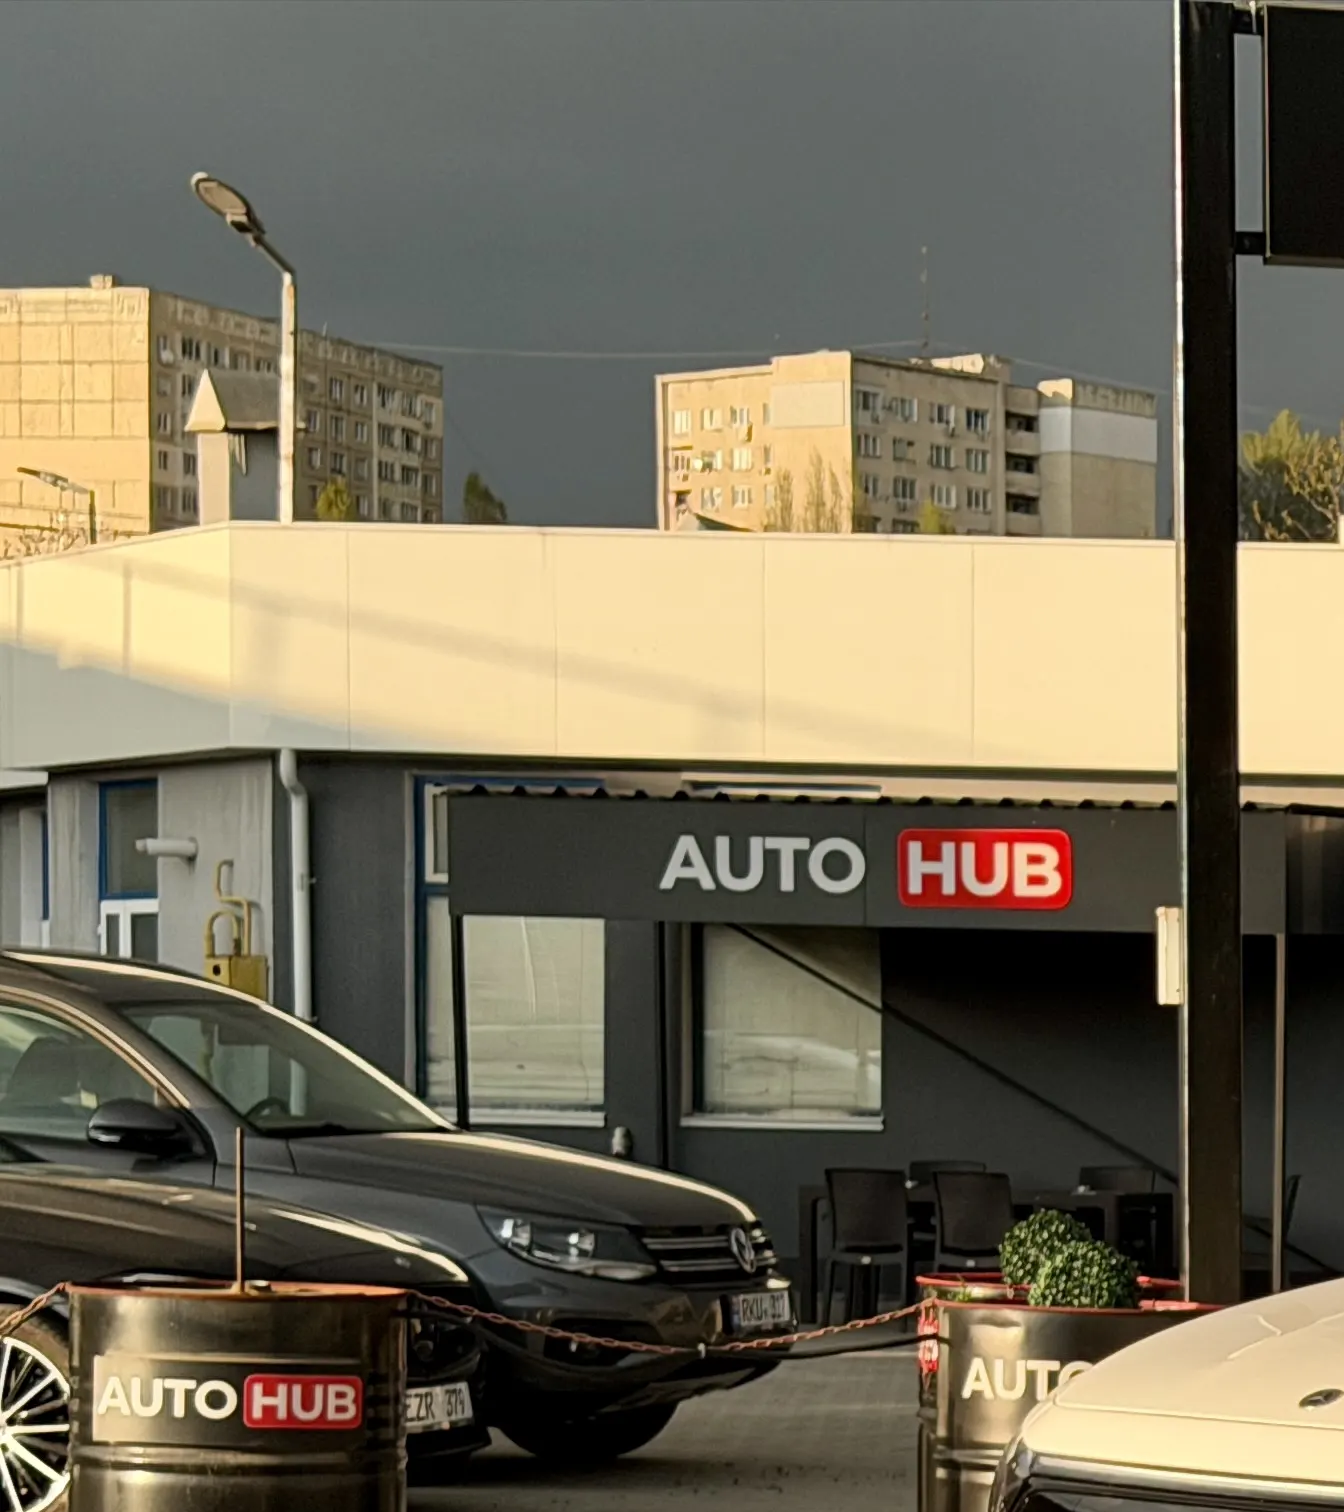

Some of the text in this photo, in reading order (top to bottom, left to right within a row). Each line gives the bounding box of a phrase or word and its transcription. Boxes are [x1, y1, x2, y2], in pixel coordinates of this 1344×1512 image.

[660, 834, 1062, 898] AUTO HUB
[98, 1376, 356, 1421] AUTO HUB
